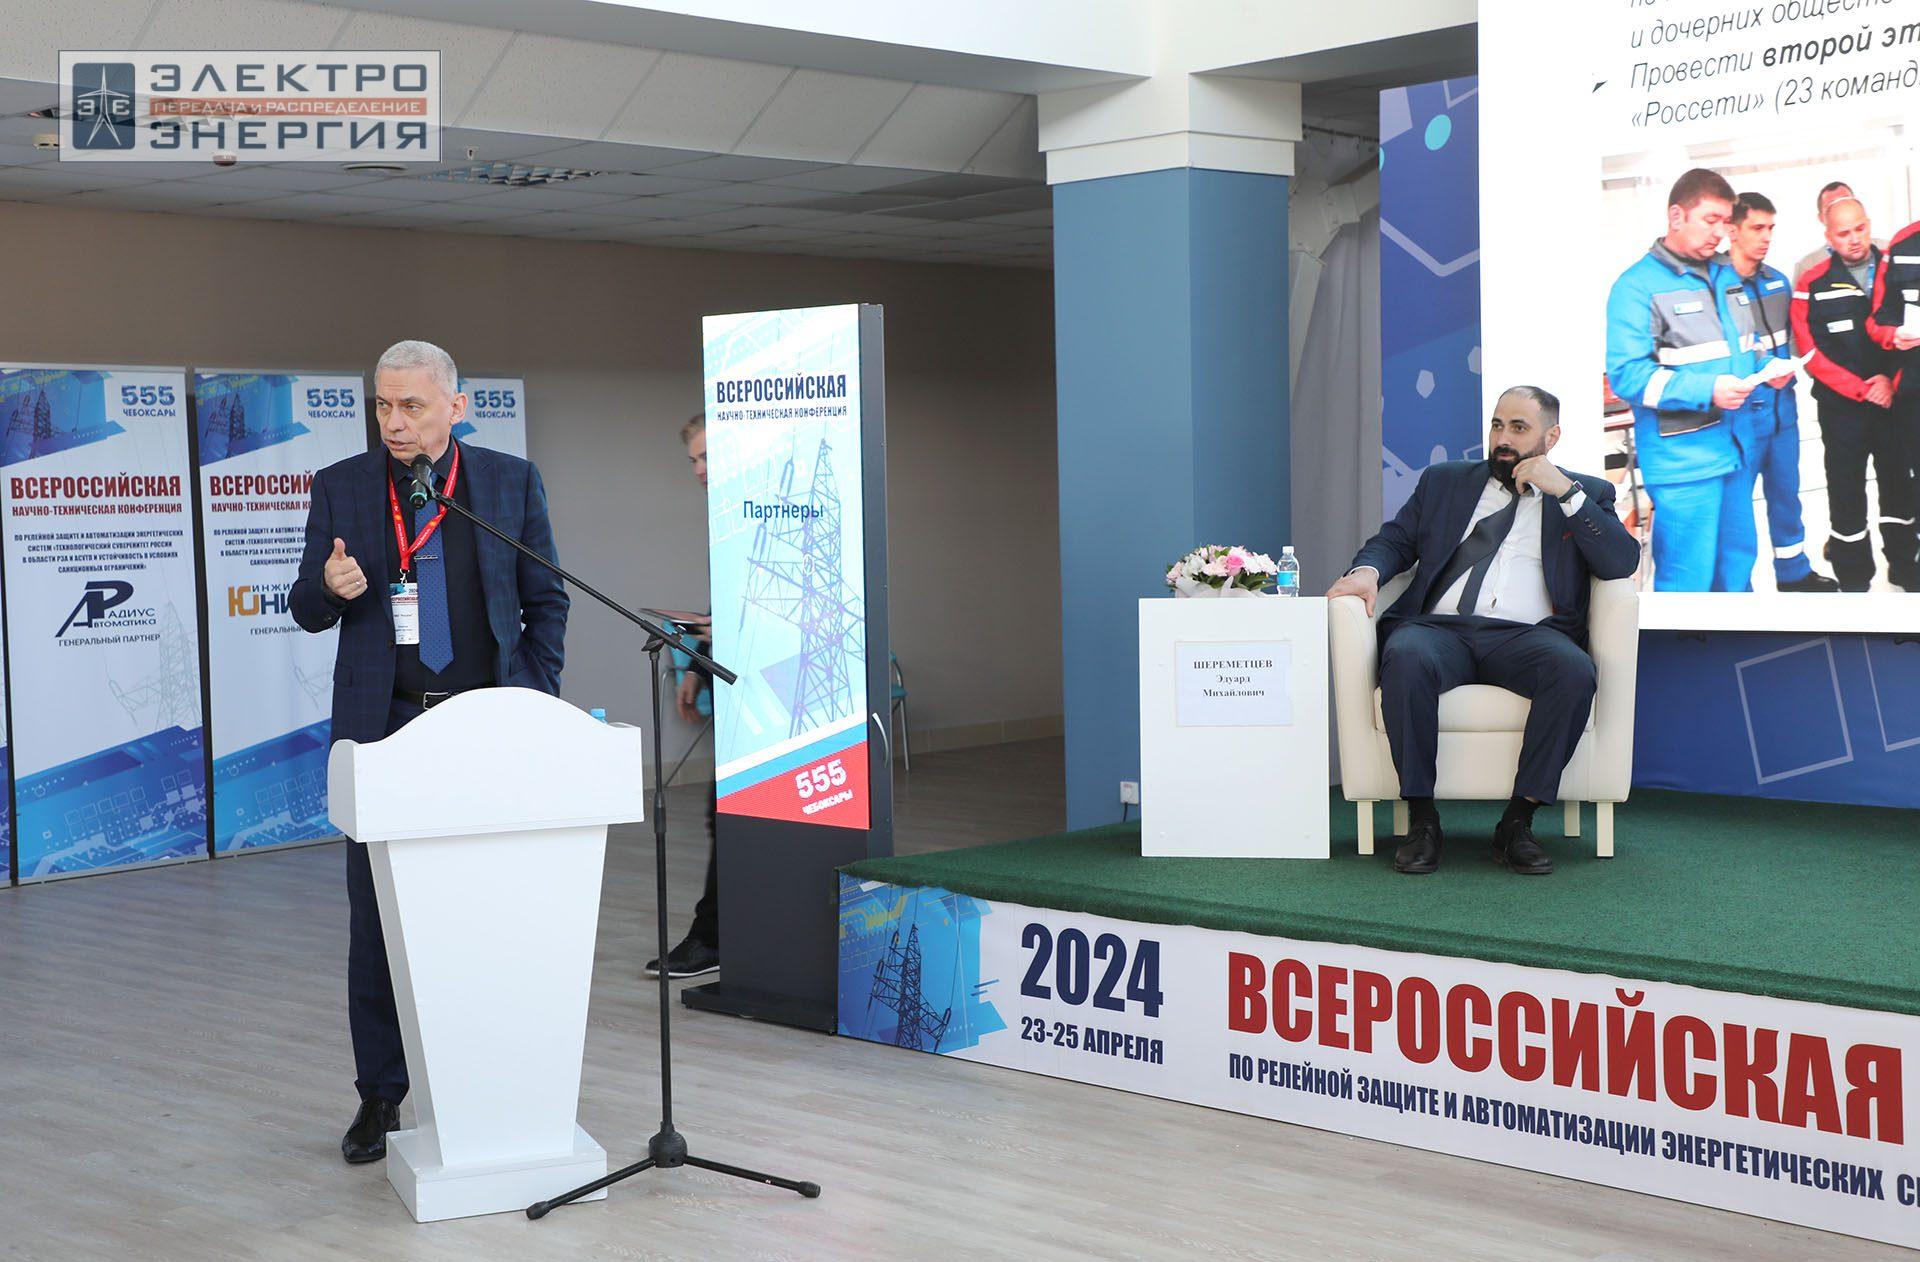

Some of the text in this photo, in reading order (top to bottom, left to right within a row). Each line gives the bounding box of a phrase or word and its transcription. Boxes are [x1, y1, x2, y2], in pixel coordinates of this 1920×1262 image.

[1631, 29, 1643, 48] и
[1651, 8, 1763, 45] дочерних
[1631, 52, 1752, 92] Провести
[1762, 24, 1872, 65] второй
[1631, 59, 1920, 127] «Россети» (23 команд
[121, 385, 175, 406] 555
[306, 388, 355, 408] 555
[716, 372, 847, 403] ВСЕРОССИЙСКАЯ
[474, 390, 516, 409] 555
[122, 408, 176, 418] ЧЕБОКСАРЫ
[308, 410, 355, 419] ЧЕБОКСАРЫ
[475, 411, 516, 419] ЧЕБОКСАРЫ
[794, 405, 847, 418] КОНФЕРЕНЦИЯ
[10, 472, 181, 500] ВСЕРОССИЙСКАЯ
[209, 470, 314, 497] ВСЕРОССИЙ
[12, 503, 183, 517] НАУЧНО-ТЕХНИЧЕСКАЯ КОНФЕРЕНЦИЯ
[211, 501, 301, 513] НАУЧНО-ТЕХНИЧЕСКАЯ
[743, 501, 824, 522] Партнеры
[250, 624, 304, 635] ГЕНЕРАЛЬНЫ
[58, 634, 161, 647] ГЕНЕРАЛЬНЫЙ ПАРТНЕР
[1193, 660, 1273, 669] ШЕРЕМЕТЦЕВ
[1216, 675, 1251, 684] Эдуард
[1203, 688, 1265, 697] Михайлович
[795, 758, 847, 799] 555
[802, 789, 853, 815] ЧЕБОКСАРЫ
[1020, 922, 1164, 1018] 2024
[1020, 1016, 1164, 1065] 23-25 АПРЕЛЯ
[1228, 951, 1904, 1146] ВСЕРОССИЙСКАЯ
[1229, 1052, 1920, 1208] ПО РЕЛЕЙНОЙ ЗАЩИТЕ И АВТОМАТИЗАЦИИ ЭНЕРГЕТИЧЕСКИХ С
